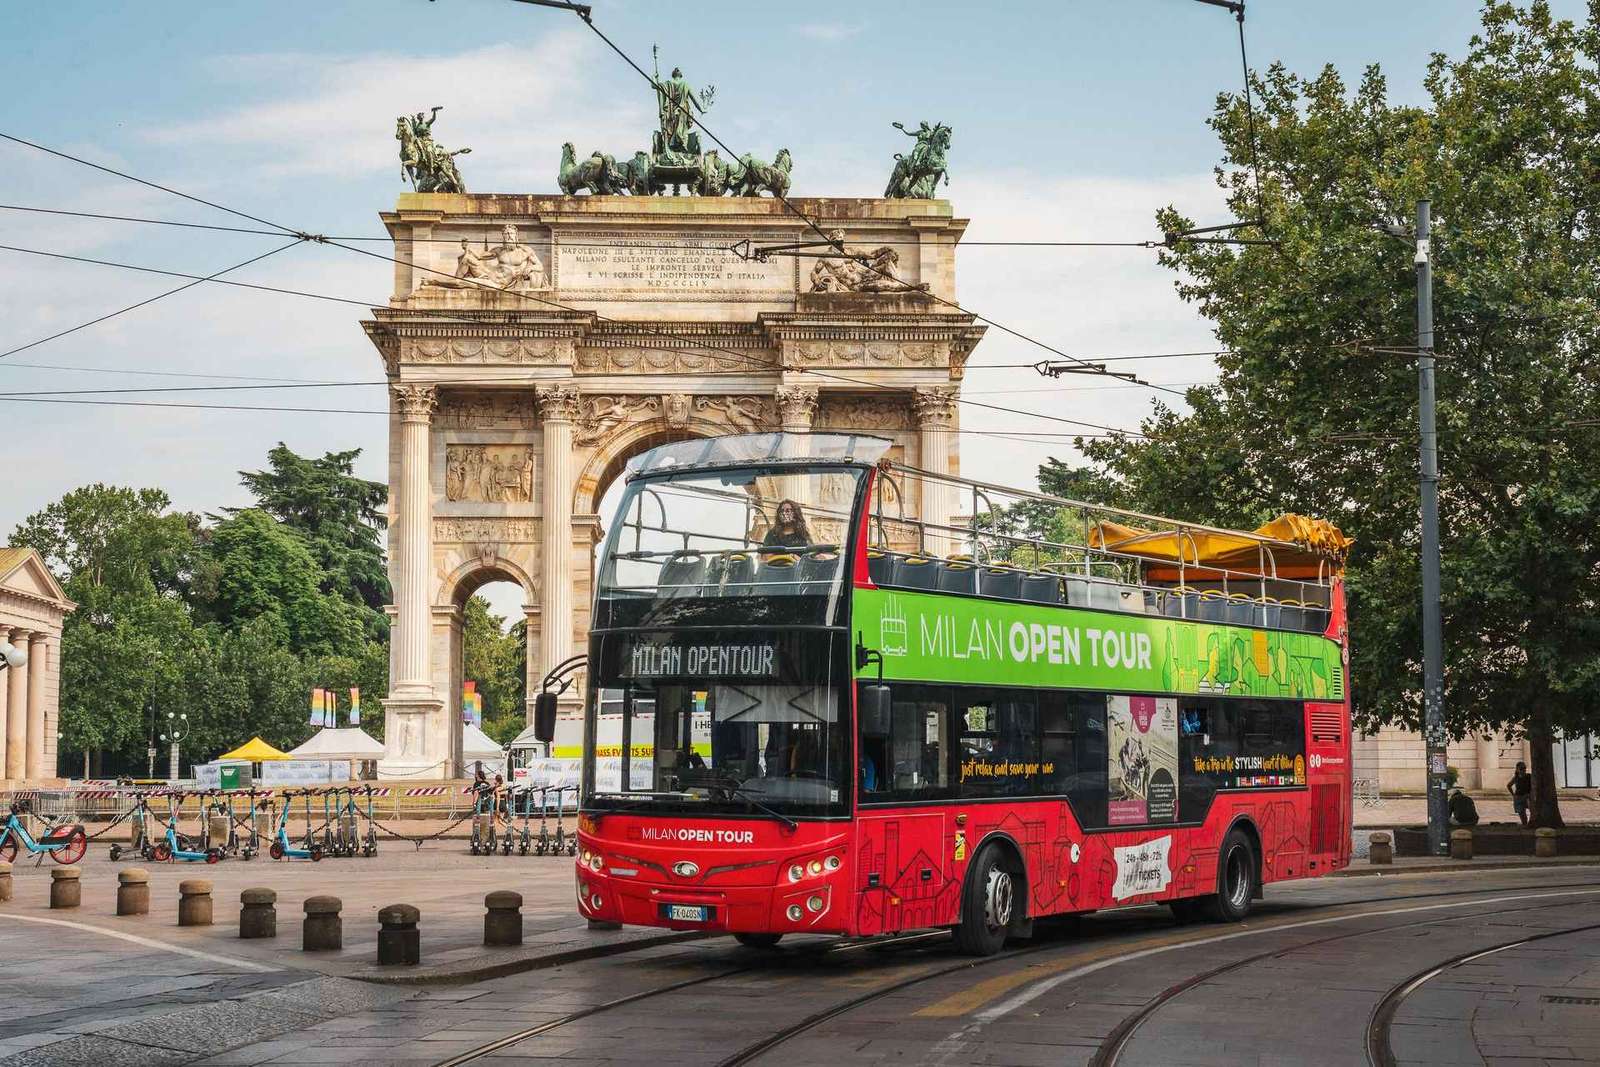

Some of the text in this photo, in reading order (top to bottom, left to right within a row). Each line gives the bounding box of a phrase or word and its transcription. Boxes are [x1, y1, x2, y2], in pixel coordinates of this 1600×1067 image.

[920, 612, 1152, 669] MILAN OPEN TOUR
[632, 646, 774, 676] MILAN OPENTOUR
[960, 758, 976, 783] just
[976, 759, 993, 776] relax
[994, 759, 1008, 777] and
[1010, 763, 1024, 776] save
[1025, 763, 1039, 779] your
[1234, 756, 1262, 770] STYLISH
[642, 828, 754, 843] MILAN OPEN TOUR
[1139, 869, 1160, 880] TICKETS
